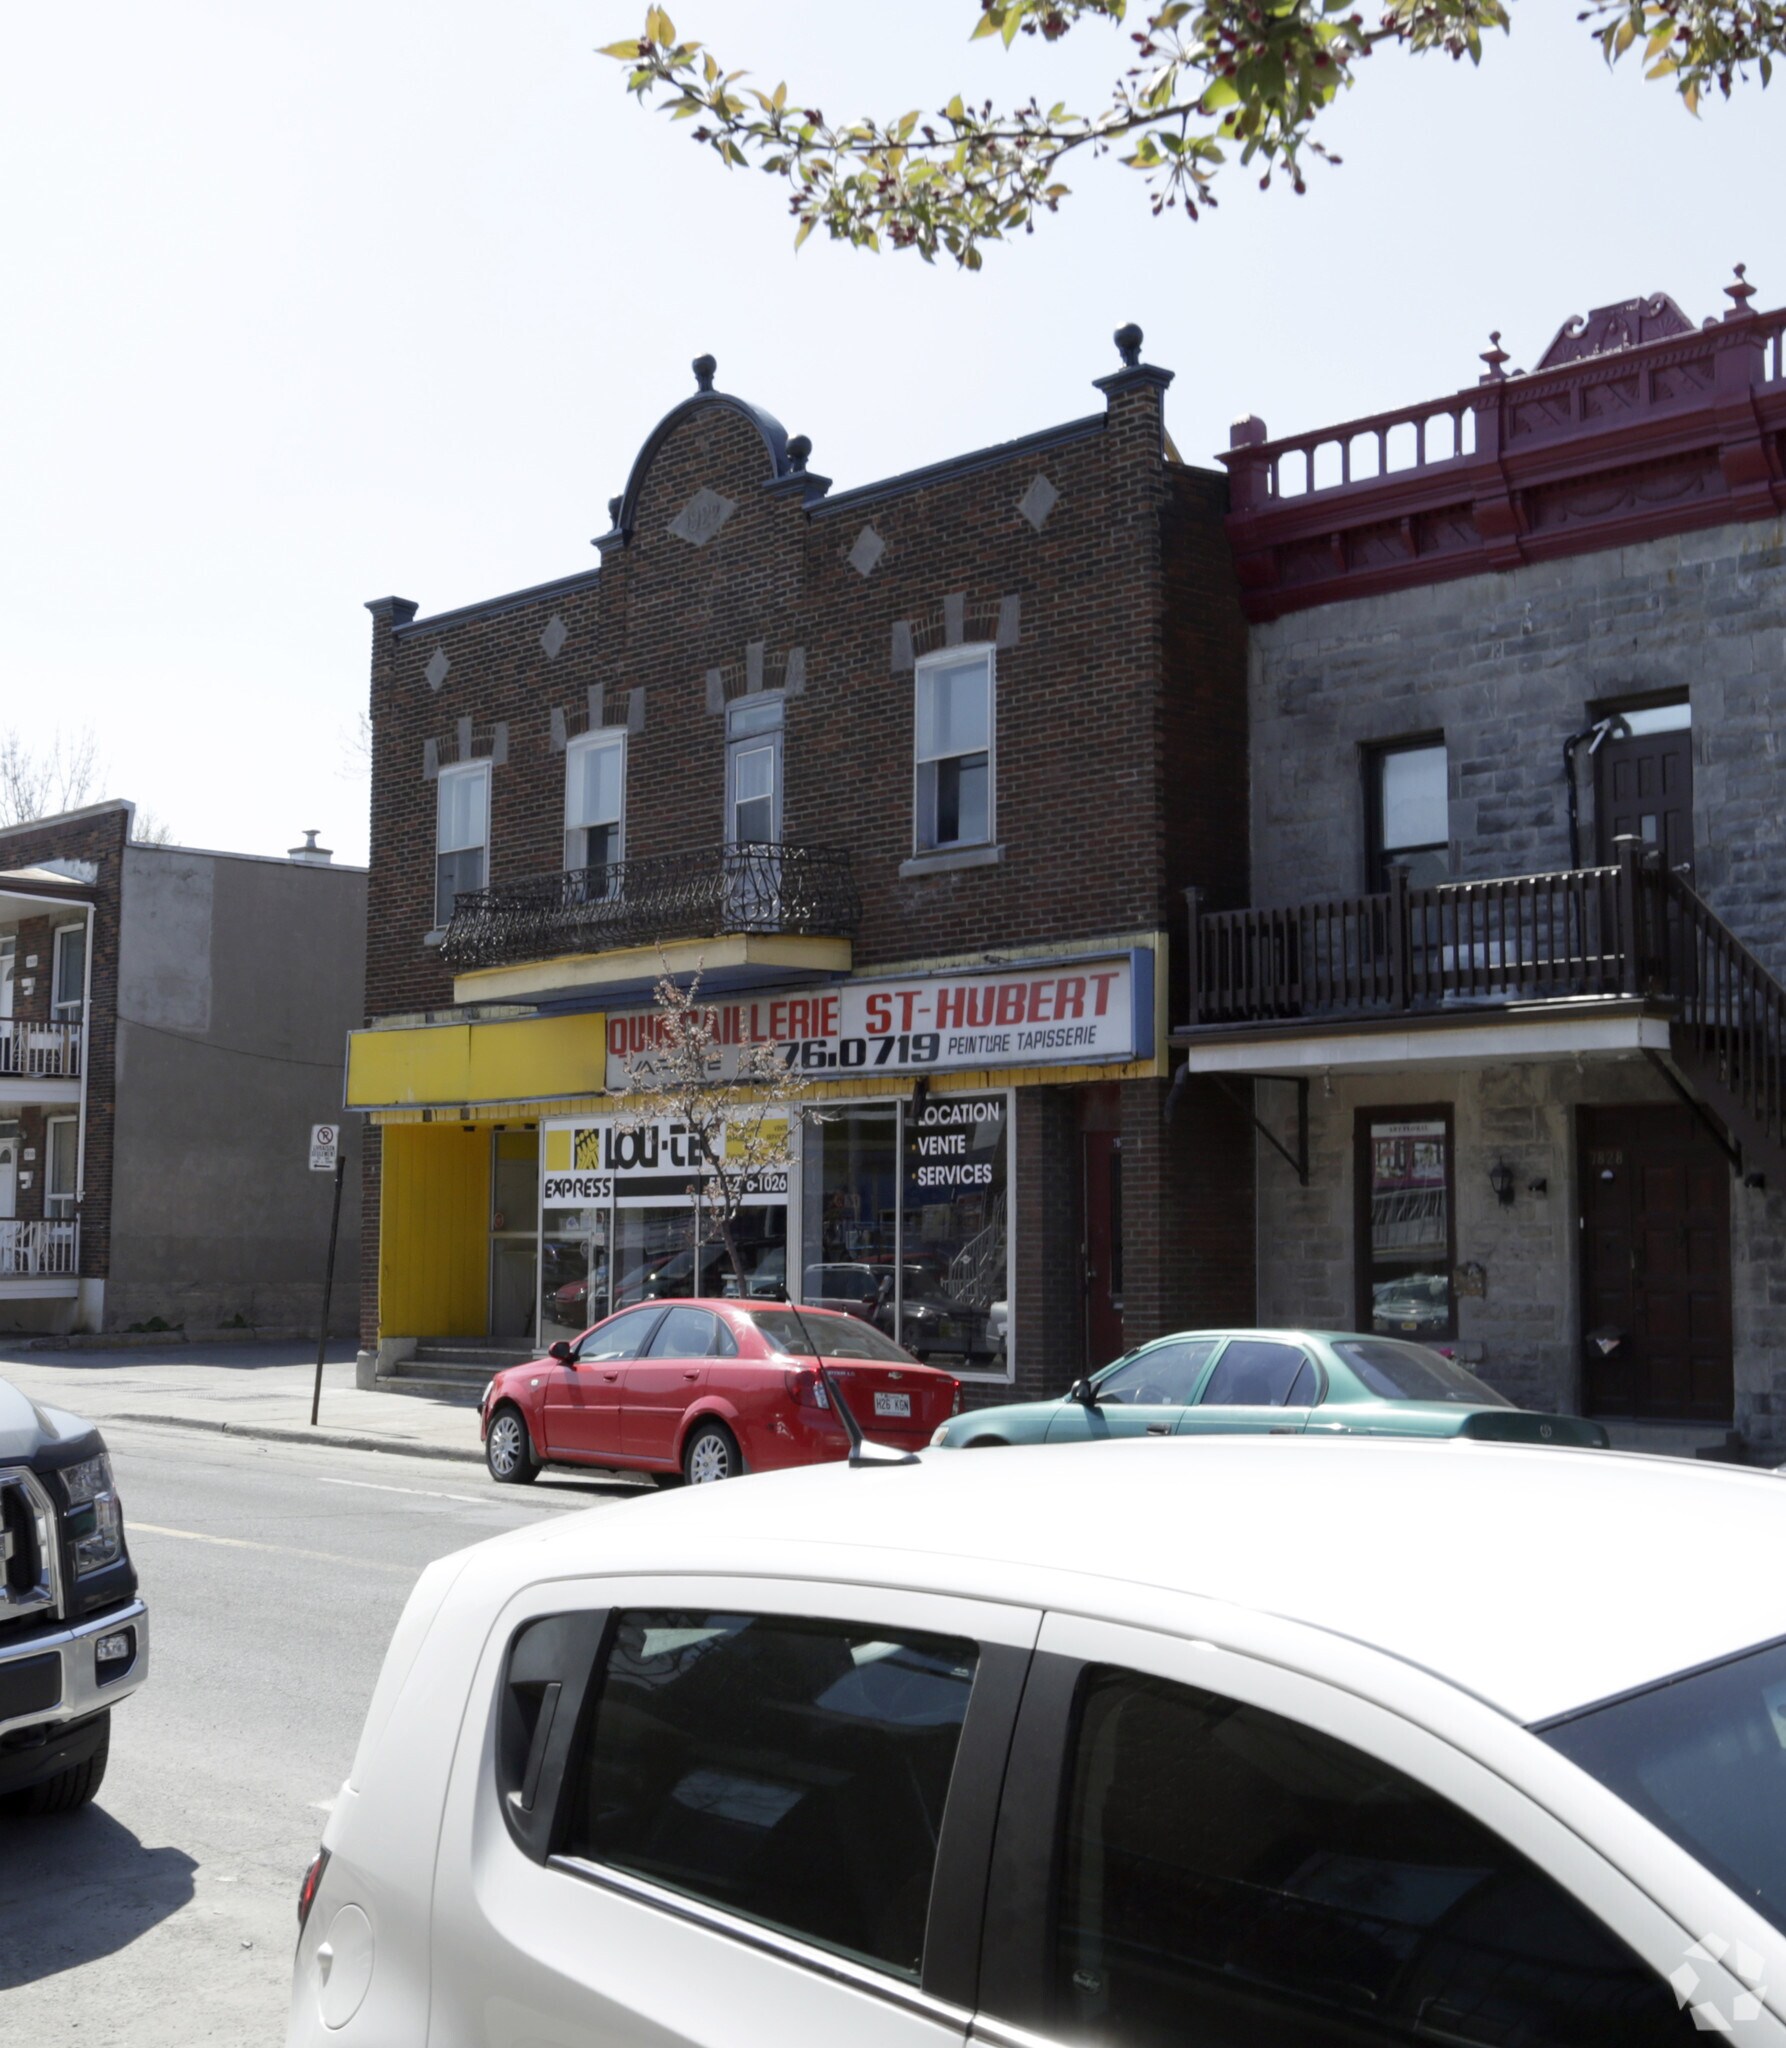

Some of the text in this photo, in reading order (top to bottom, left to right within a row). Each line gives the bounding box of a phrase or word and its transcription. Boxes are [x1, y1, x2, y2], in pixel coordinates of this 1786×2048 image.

[865, 972, 1119, 1034] ST-HUBERT
[949, 1034, 1011, 1055] PEINTURE
[1017, 1025, 1097, 1050] TAPISSERIE
[918, 1135, 966, 1155] VENTE
[917, 1164, 992, 1186] SERVICES
[545, 1178, 611, 1198] EXPRESS
